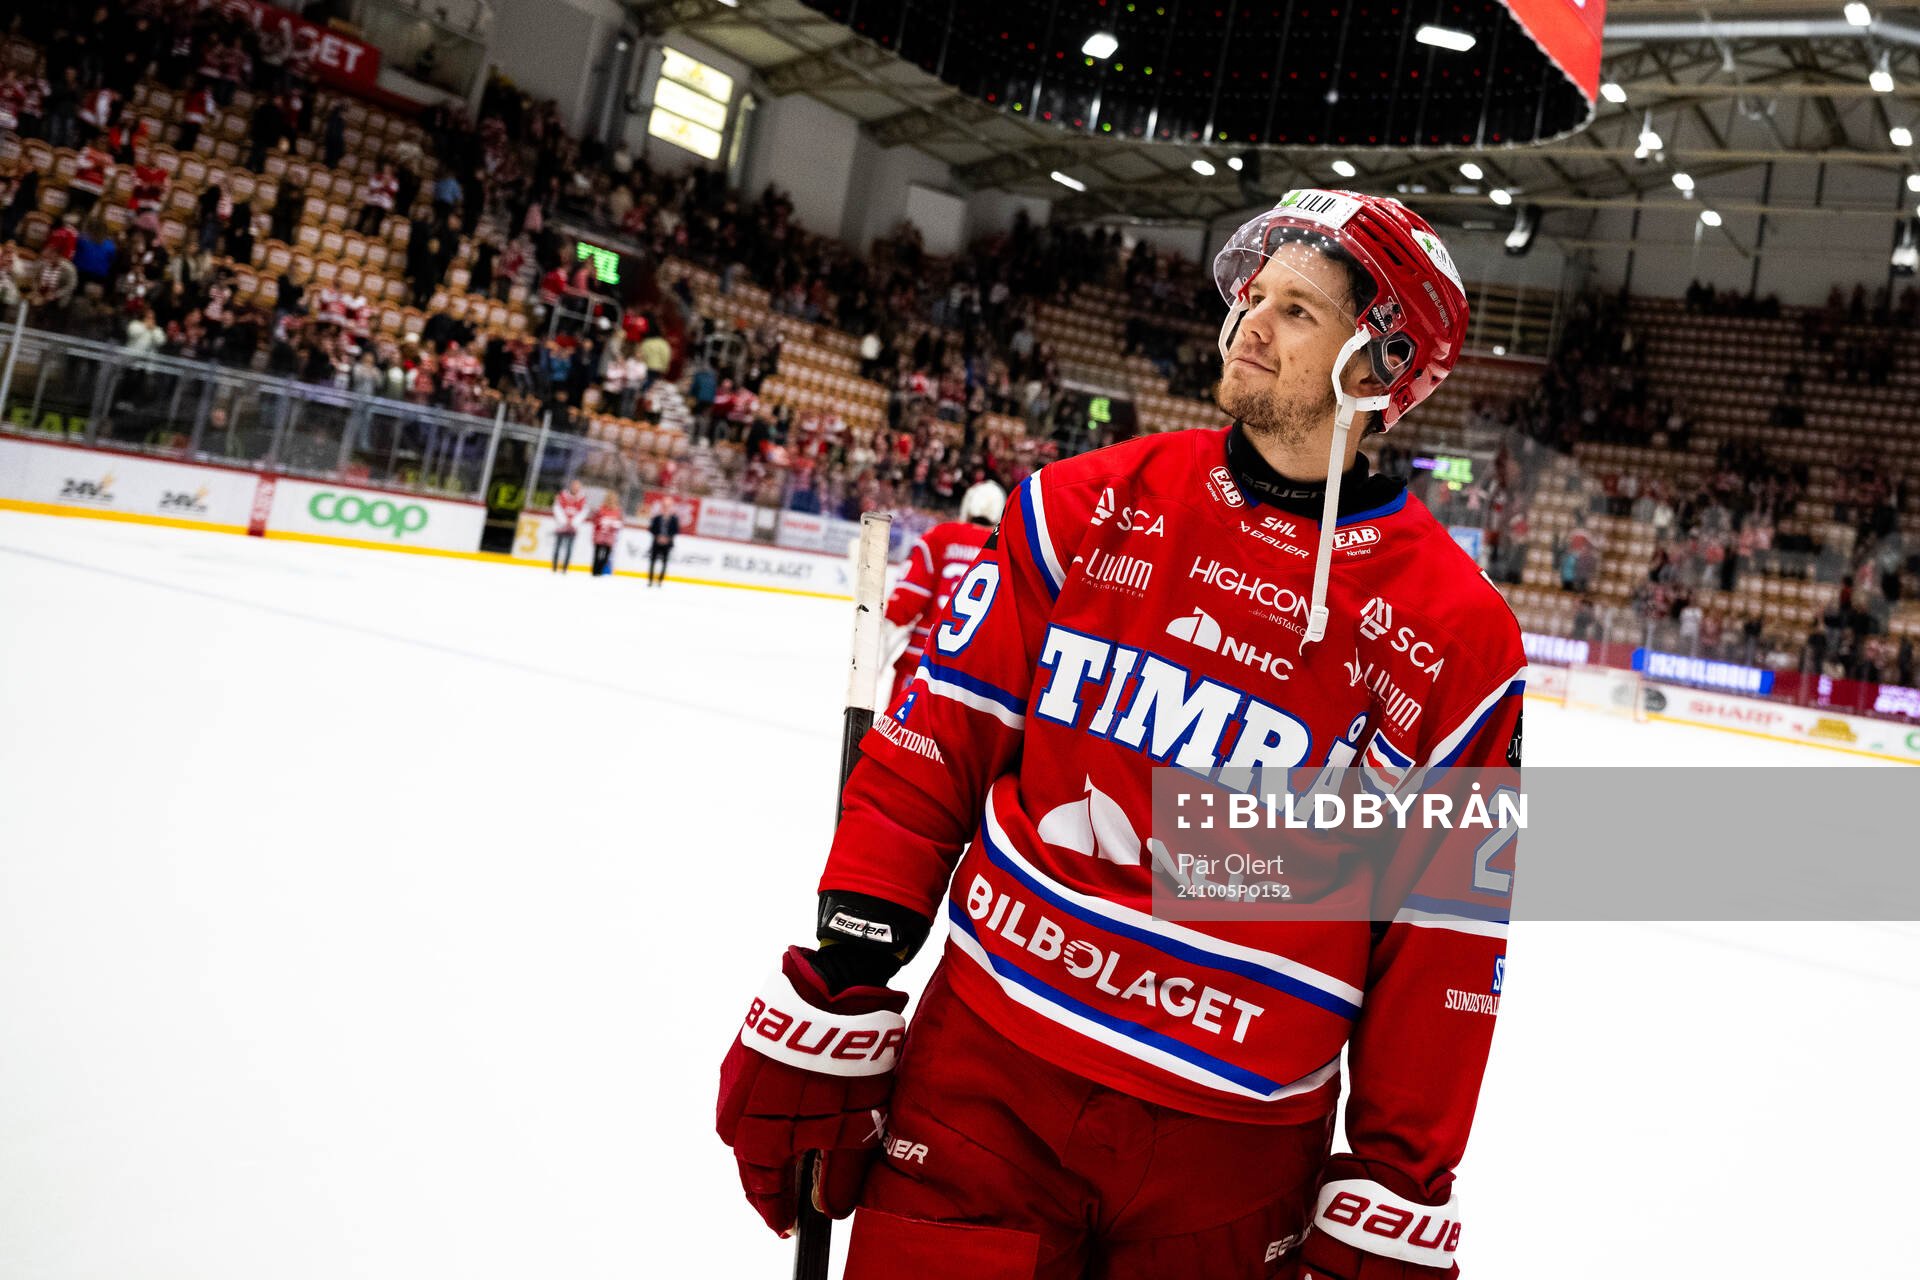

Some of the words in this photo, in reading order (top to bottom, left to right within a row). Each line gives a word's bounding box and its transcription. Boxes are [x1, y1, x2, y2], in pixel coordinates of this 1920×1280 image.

[1211, 468, 1242, 506] EAB
[1116, 506, 1165, 538] SCA
[1259, 516, 1298, 538] SHL
[1333, 528, 1378, 549] EAB
[1085, 547, 1153, 591] LILIUM
[1346, 548, 1372, 558] Norrland
[1221, 636, 1294, 681] NHC
[1391, 626, 1445, 683] SCA
[1033, 622, 1370, 835] TIMRÅ
[966, 872, 1265, 1044] BILBOLAGET
